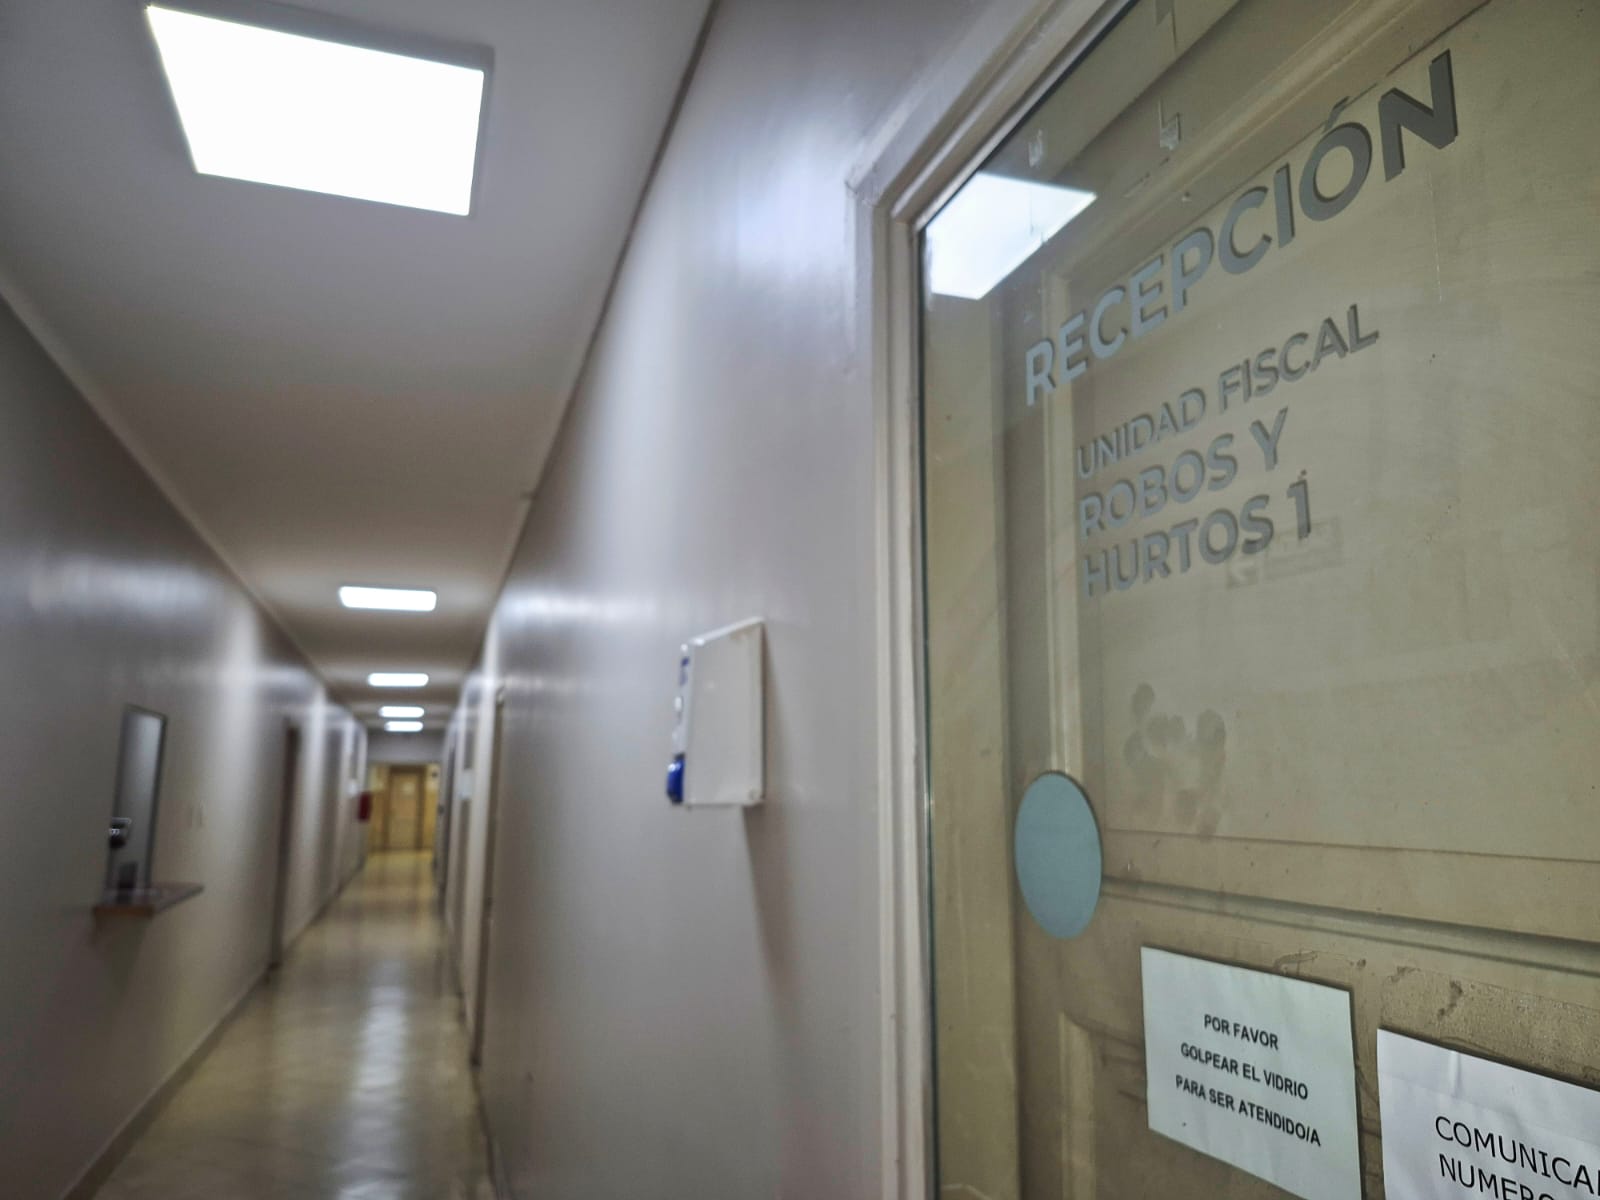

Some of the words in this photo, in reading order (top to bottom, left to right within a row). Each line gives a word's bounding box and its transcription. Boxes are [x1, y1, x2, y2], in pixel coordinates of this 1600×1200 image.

[1025, 49, 1458, 406] RECEPCIÓN
[1078, 388, 1206, 479] UNIDAD
[1218, 304, 1379, 412] FISCAL
[1080, 433, 1238, 541] ROBOS
[1250, 406, 1288, 472] Y
[1082, 494, 1274, 599] HURTOS
[1286, 479, 1312, 539] 1
[1180, 1042, 1239, 1076] GOLPEAR
[1242, 1063, 1261, 1083] EL
[1263, 1070, 1309, 1100] VIDRIO
[1204, 1014, 1230, 1036] POR
[1233, 1023, 1279, 1050] FAVOR
[1175, 1074, 1206, 1101] PARA
[1209, 1088, 1235, 1112] SER
[1238, 1100, 1321, 1147] ATENDIDO/A
[1435, 1116, 1600, 1196] COMUNICA
[1439, 1153, 1556, 1200] NUMER
